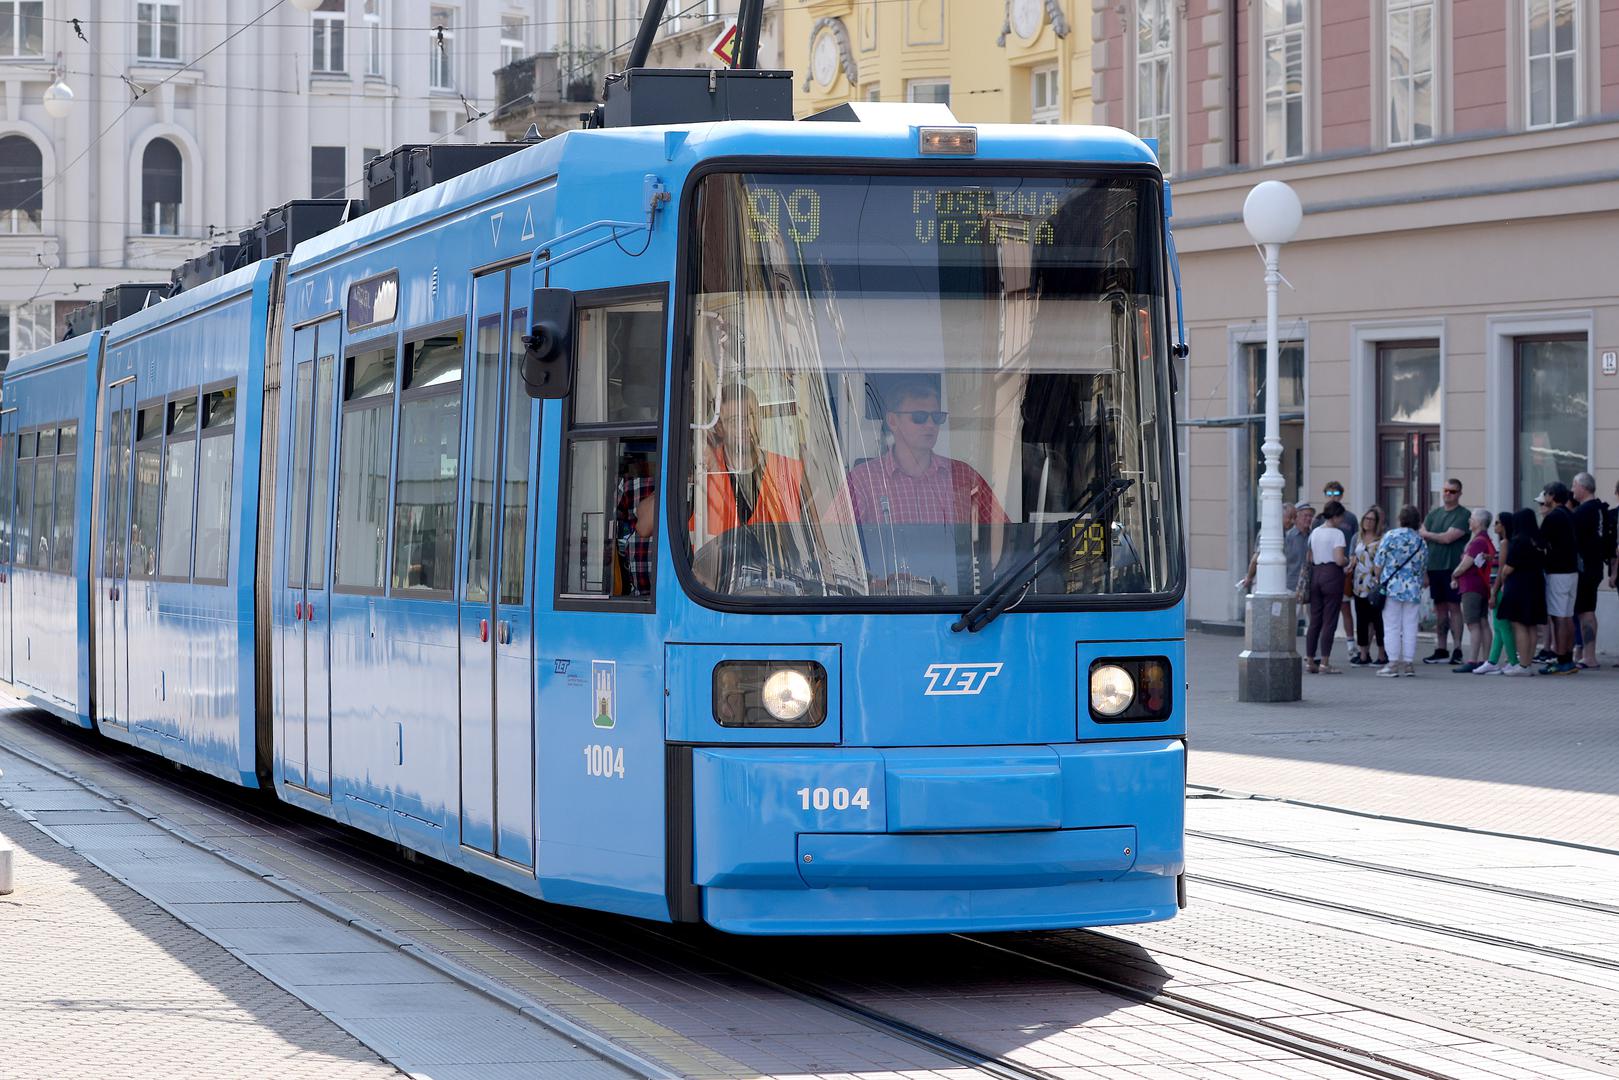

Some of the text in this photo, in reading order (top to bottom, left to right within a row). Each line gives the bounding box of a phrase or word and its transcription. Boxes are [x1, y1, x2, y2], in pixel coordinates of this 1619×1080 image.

[747, 188, 821, 243] 99
[913, 189, 1058, 215] POSEBNA
[924, 662, 1004, 696] ZET
[584, 744, 625, 779] 1004
[797, 787, 870, 810] 1004
